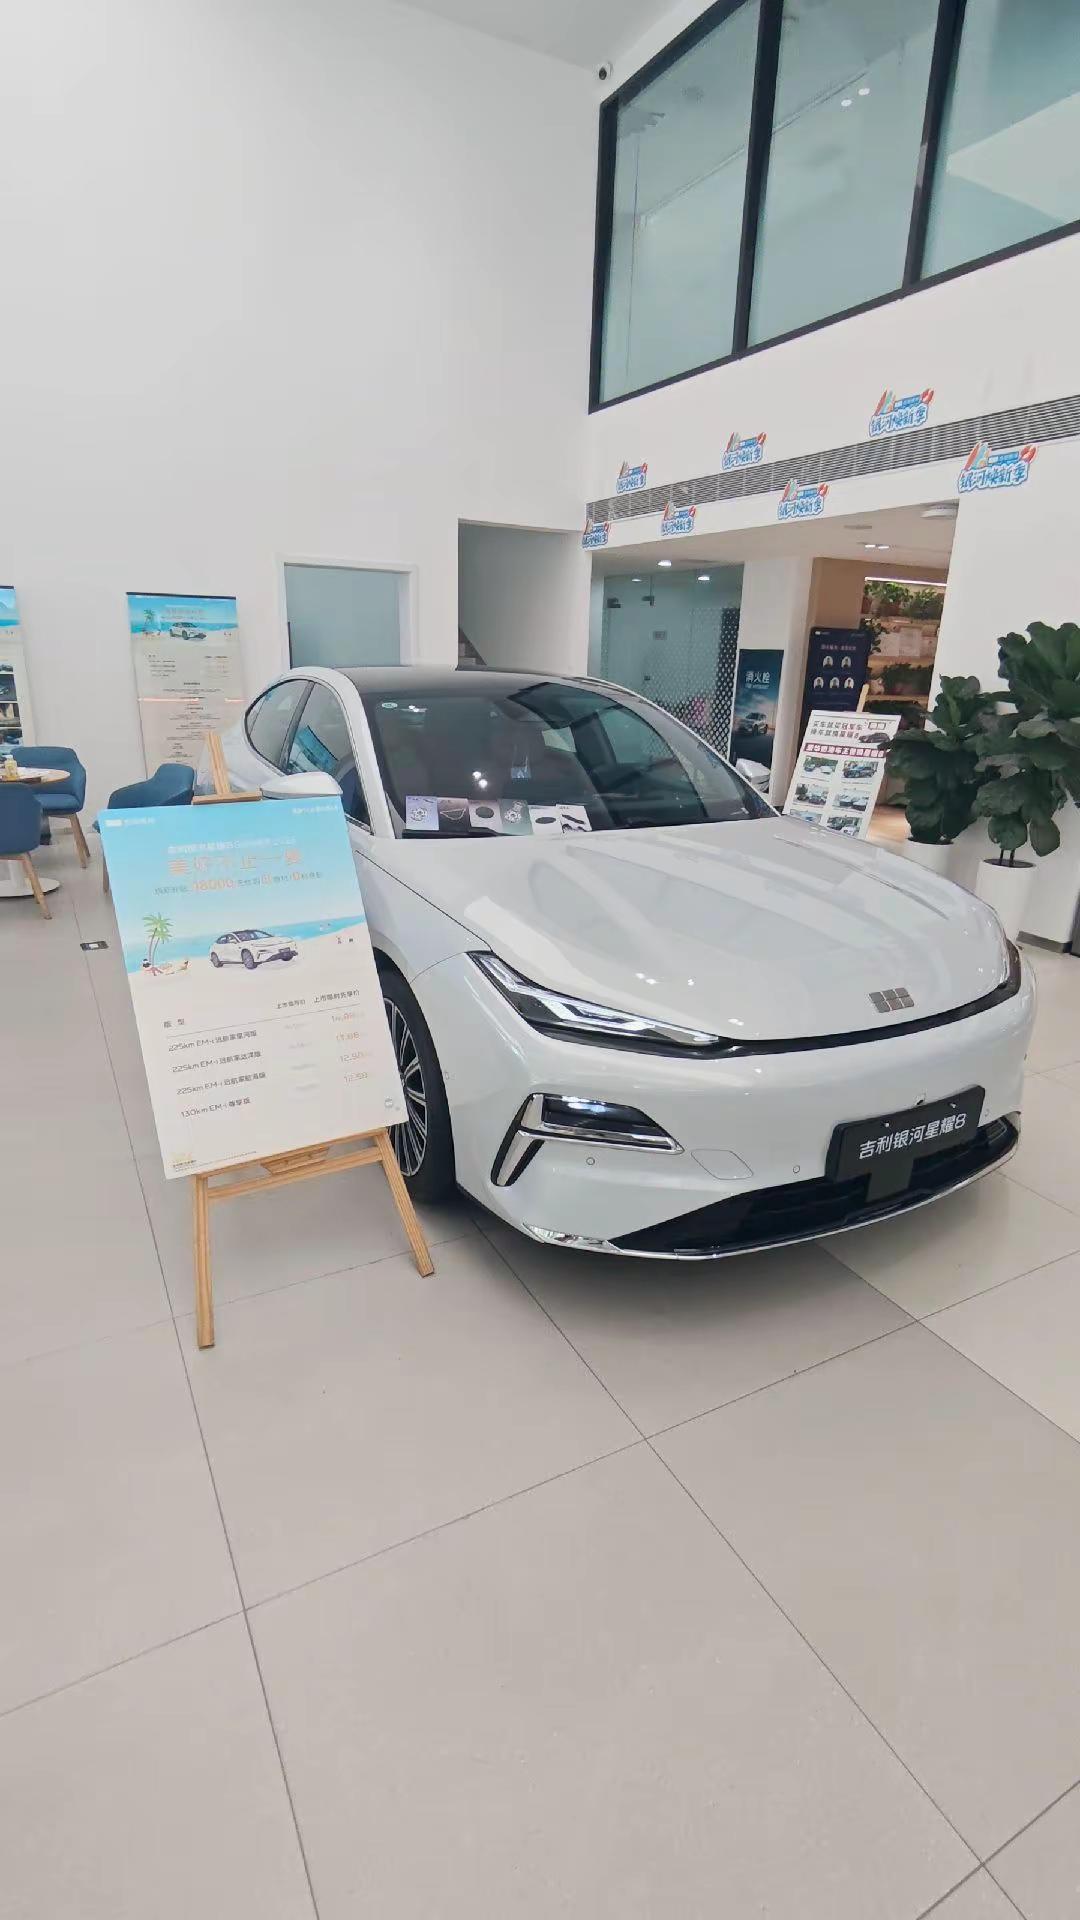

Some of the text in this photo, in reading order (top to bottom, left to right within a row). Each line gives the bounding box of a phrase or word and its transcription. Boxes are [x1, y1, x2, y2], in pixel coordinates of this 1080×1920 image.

[168, 1041, 195, 1051] 225km
[173, 1062, 199, 1072] 225km
[177, 1085, 203, 1095] 225km
[180, 1105, 208, 1117] 130km
[858, 1113, 967, 1160] 吉利银河星耀8
